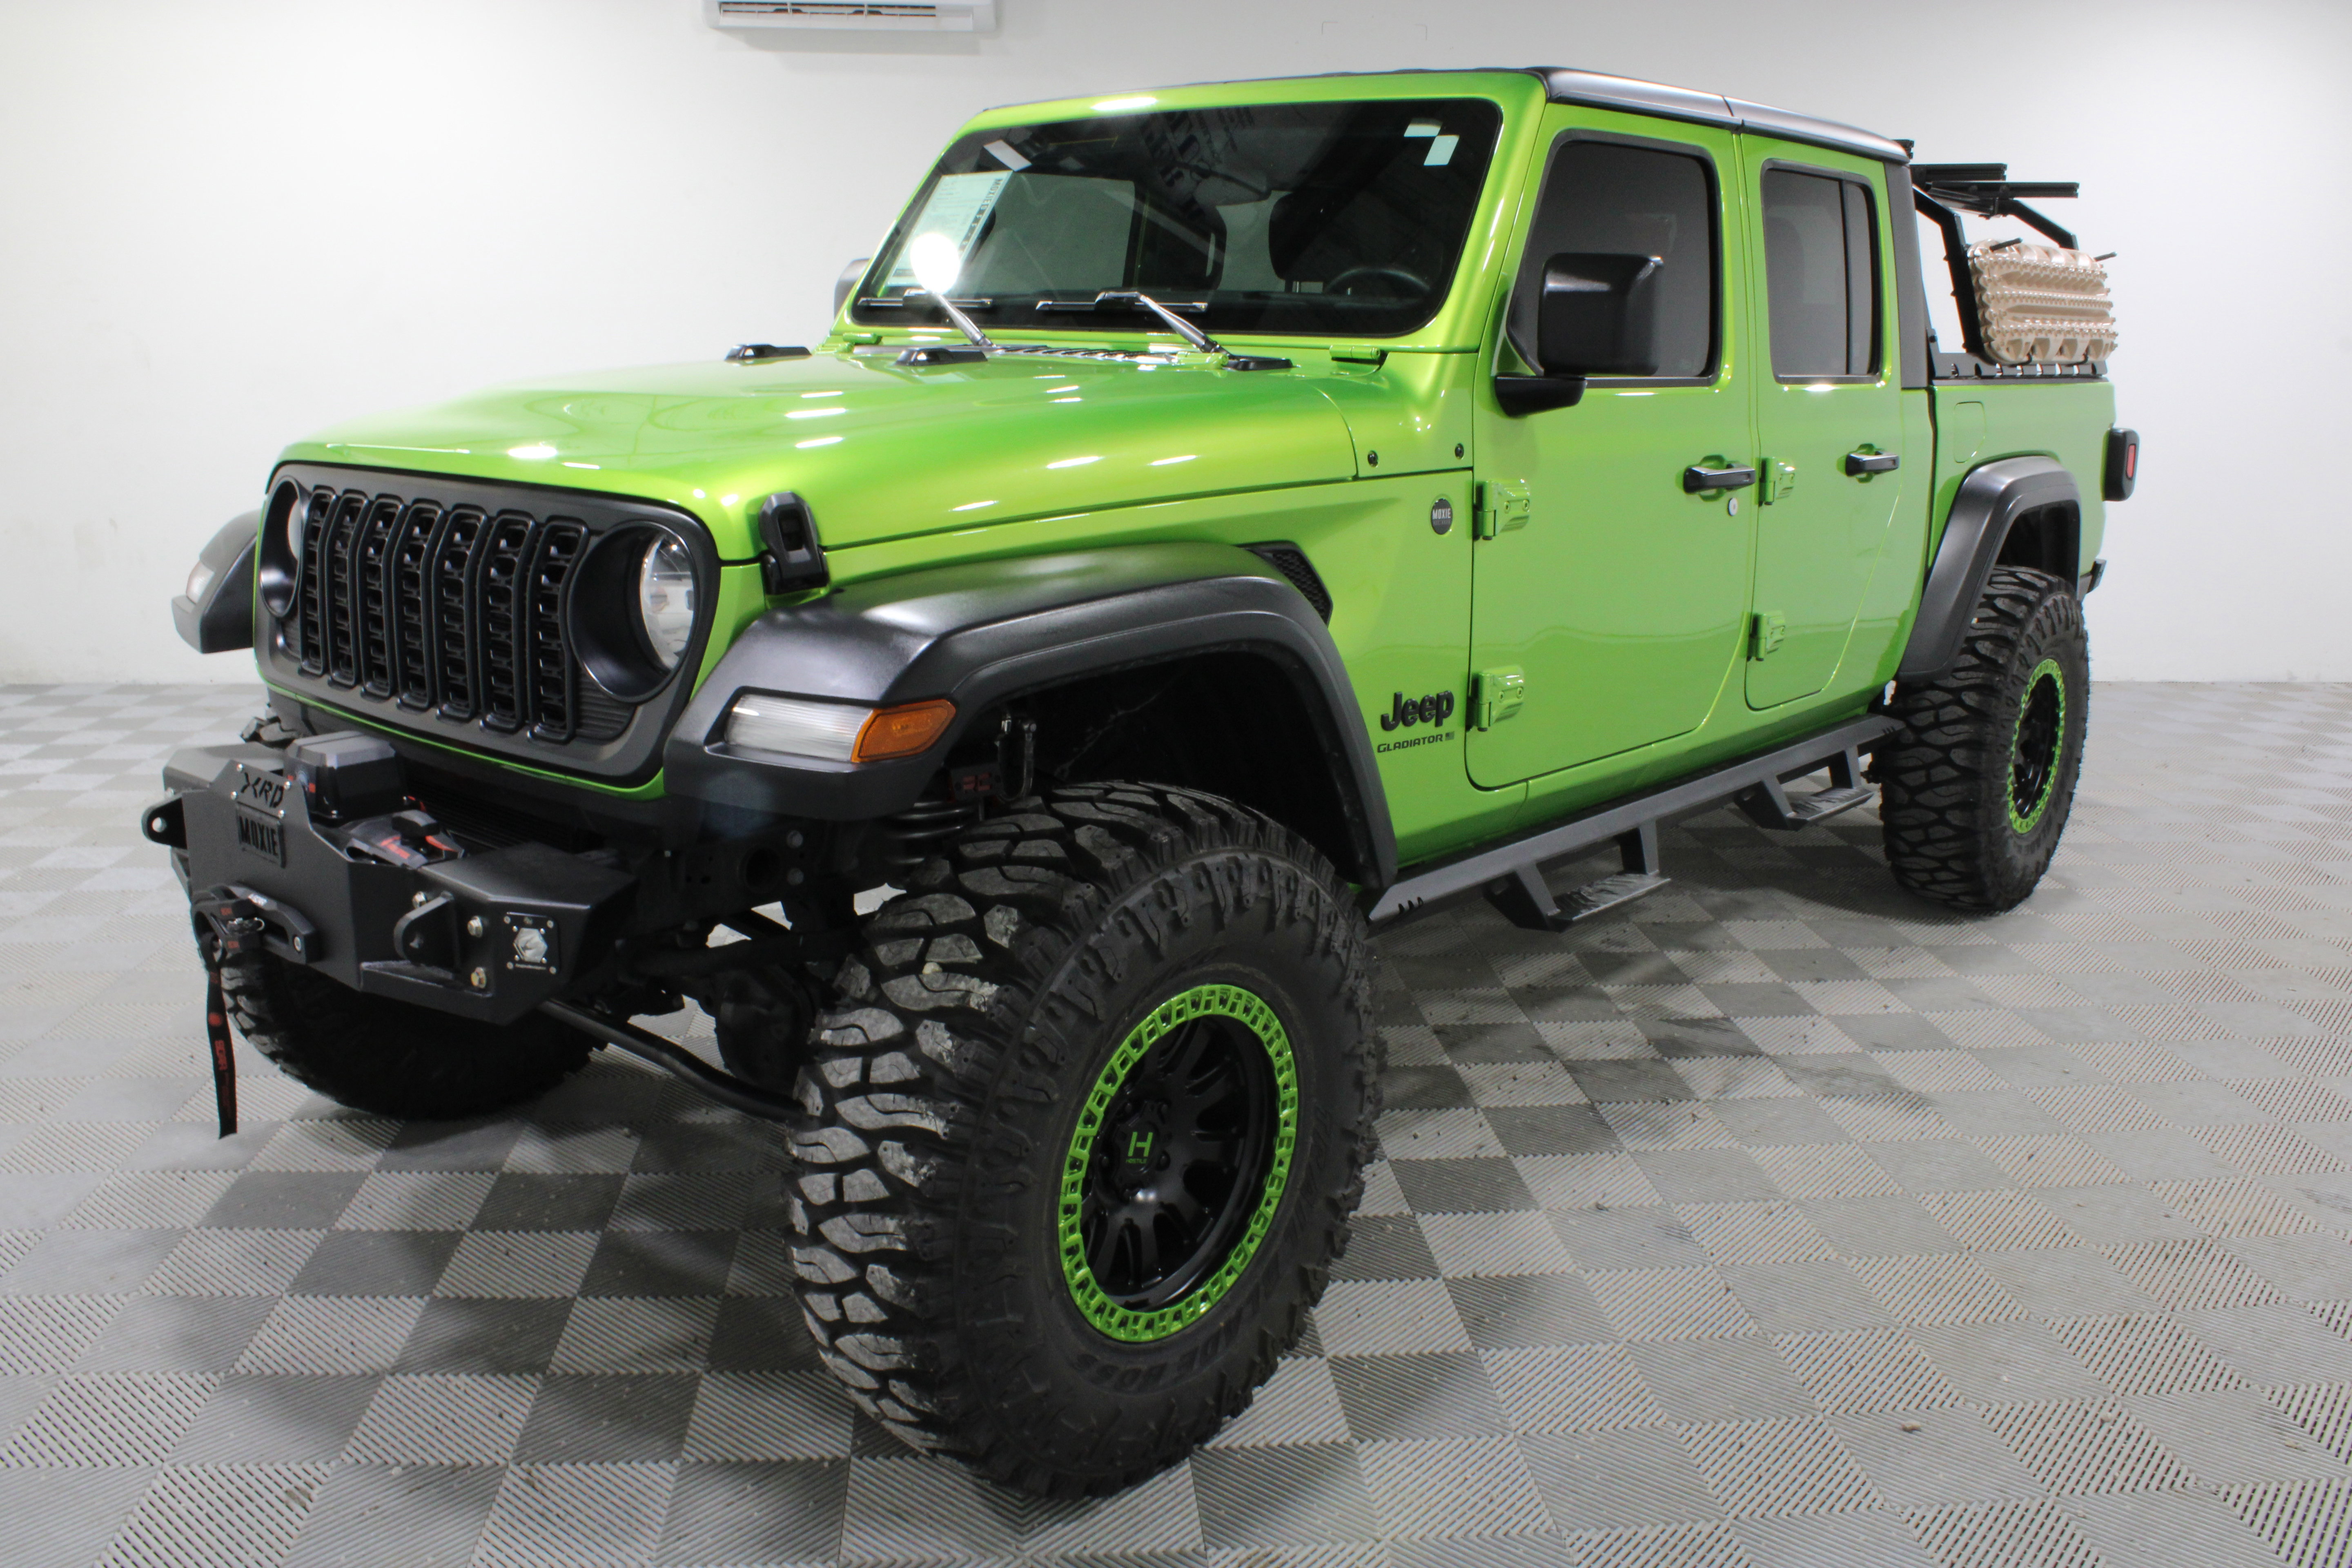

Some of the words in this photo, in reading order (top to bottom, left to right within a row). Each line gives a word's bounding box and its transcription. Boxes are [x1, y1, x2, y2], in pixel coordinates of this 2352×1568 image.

[983, 178, 1003, 203] MOXIE
[1432, 508, 1451, 519] MOXIE
[1381, 690, 1454, 731] Jeep
[1377, 734, 1443, 753] GLADIATOR
[241, 772, 284, 808] XRD
[238, 815, 279, 857] MOXIE
[1127, 1131, 1154, 1157] H
